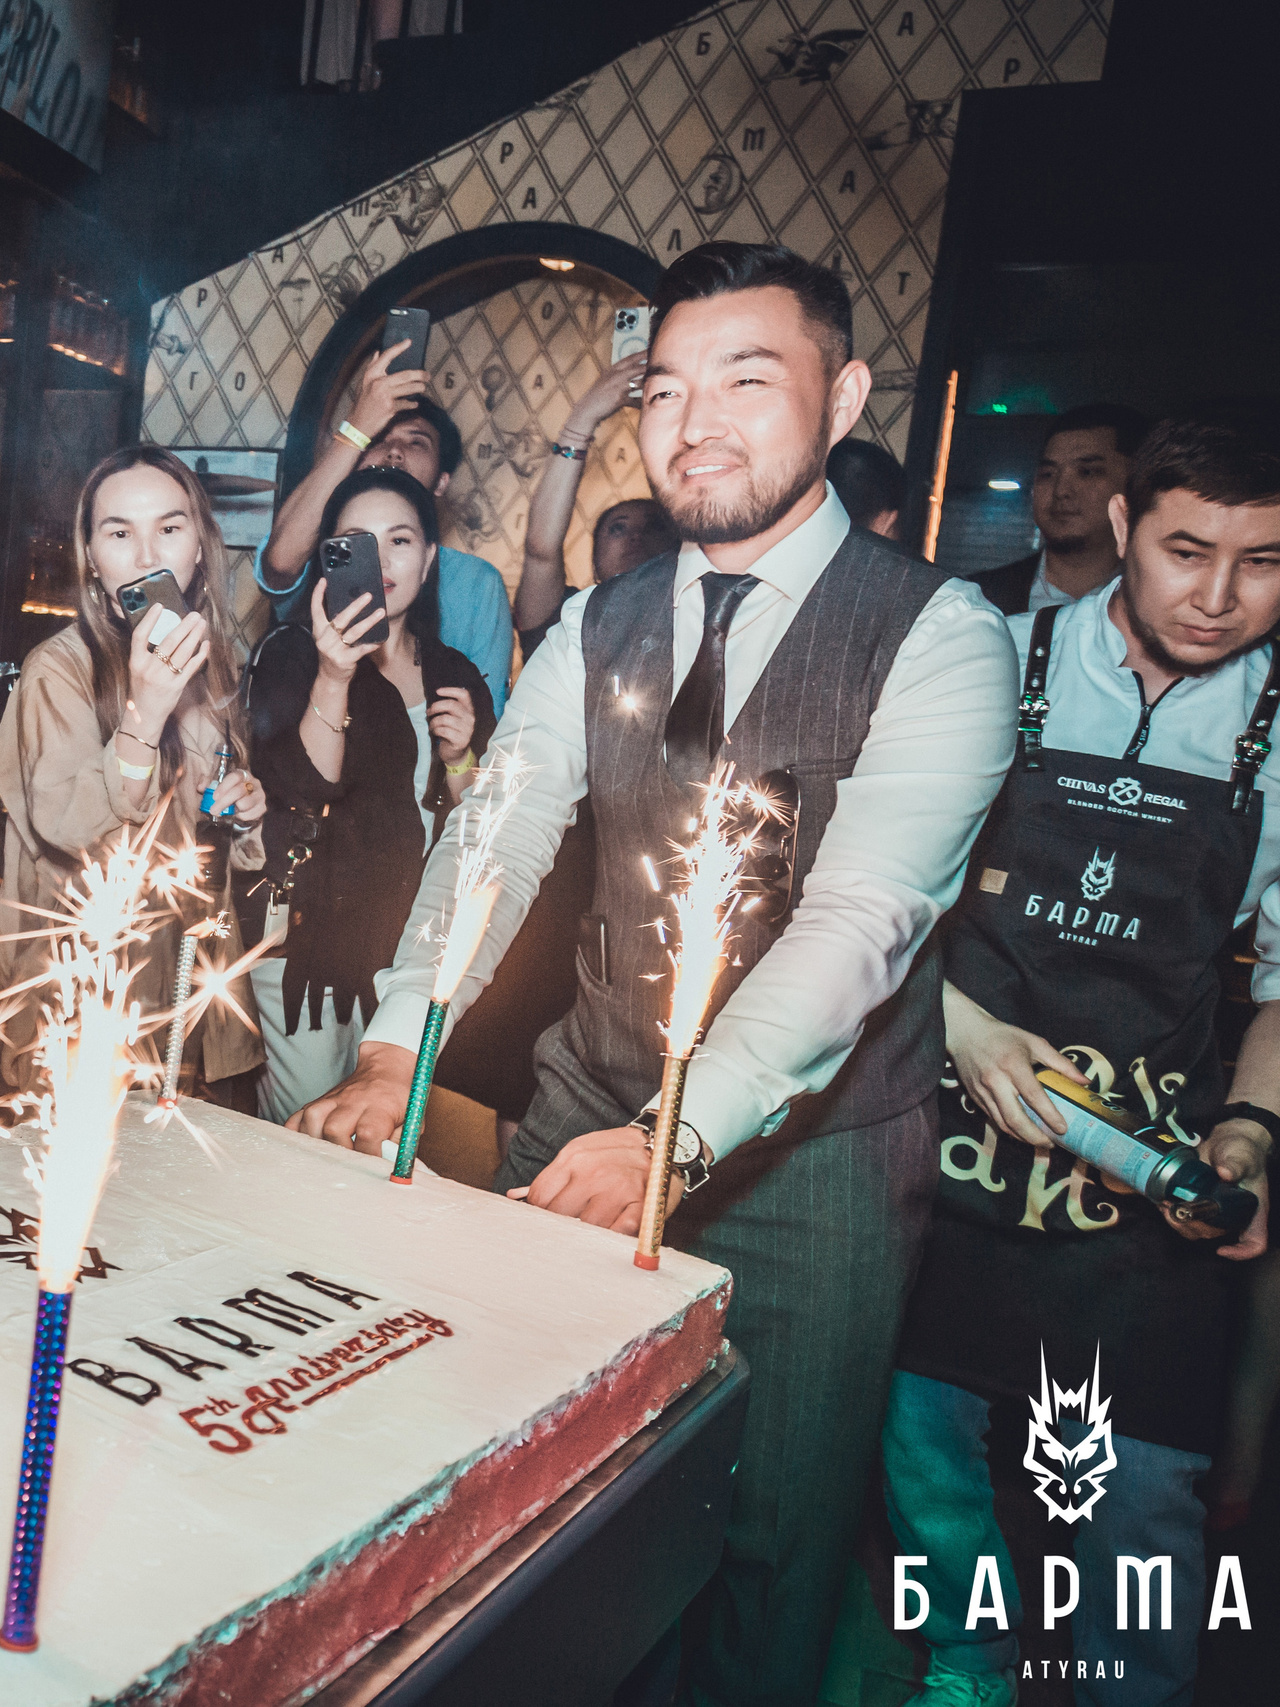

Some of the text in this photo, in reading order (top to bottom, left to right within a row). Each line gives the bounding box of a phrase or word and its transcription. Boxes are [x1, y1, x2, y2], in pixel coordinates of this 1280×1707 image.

[696, 32, 711, 56] Б
[1003, 58, 1021, 83] Р
[500, 142, 514, 164] Р
[839, 171, 856, 195] А
[522, 188, 537, 209] А
[896, 270, 911, 296] Т
[197, 288, 208, 309] Р
[189, 371, 198, 391] Г
[235, 372, 246, 392] О
[445, 372, 455, 390] Б
[1057, 776, 1188, 811] CHIVAS REGAL
[1067, 798, 1105, 811] BLENDED
[67, 1270, 380, 1406] BARMA
